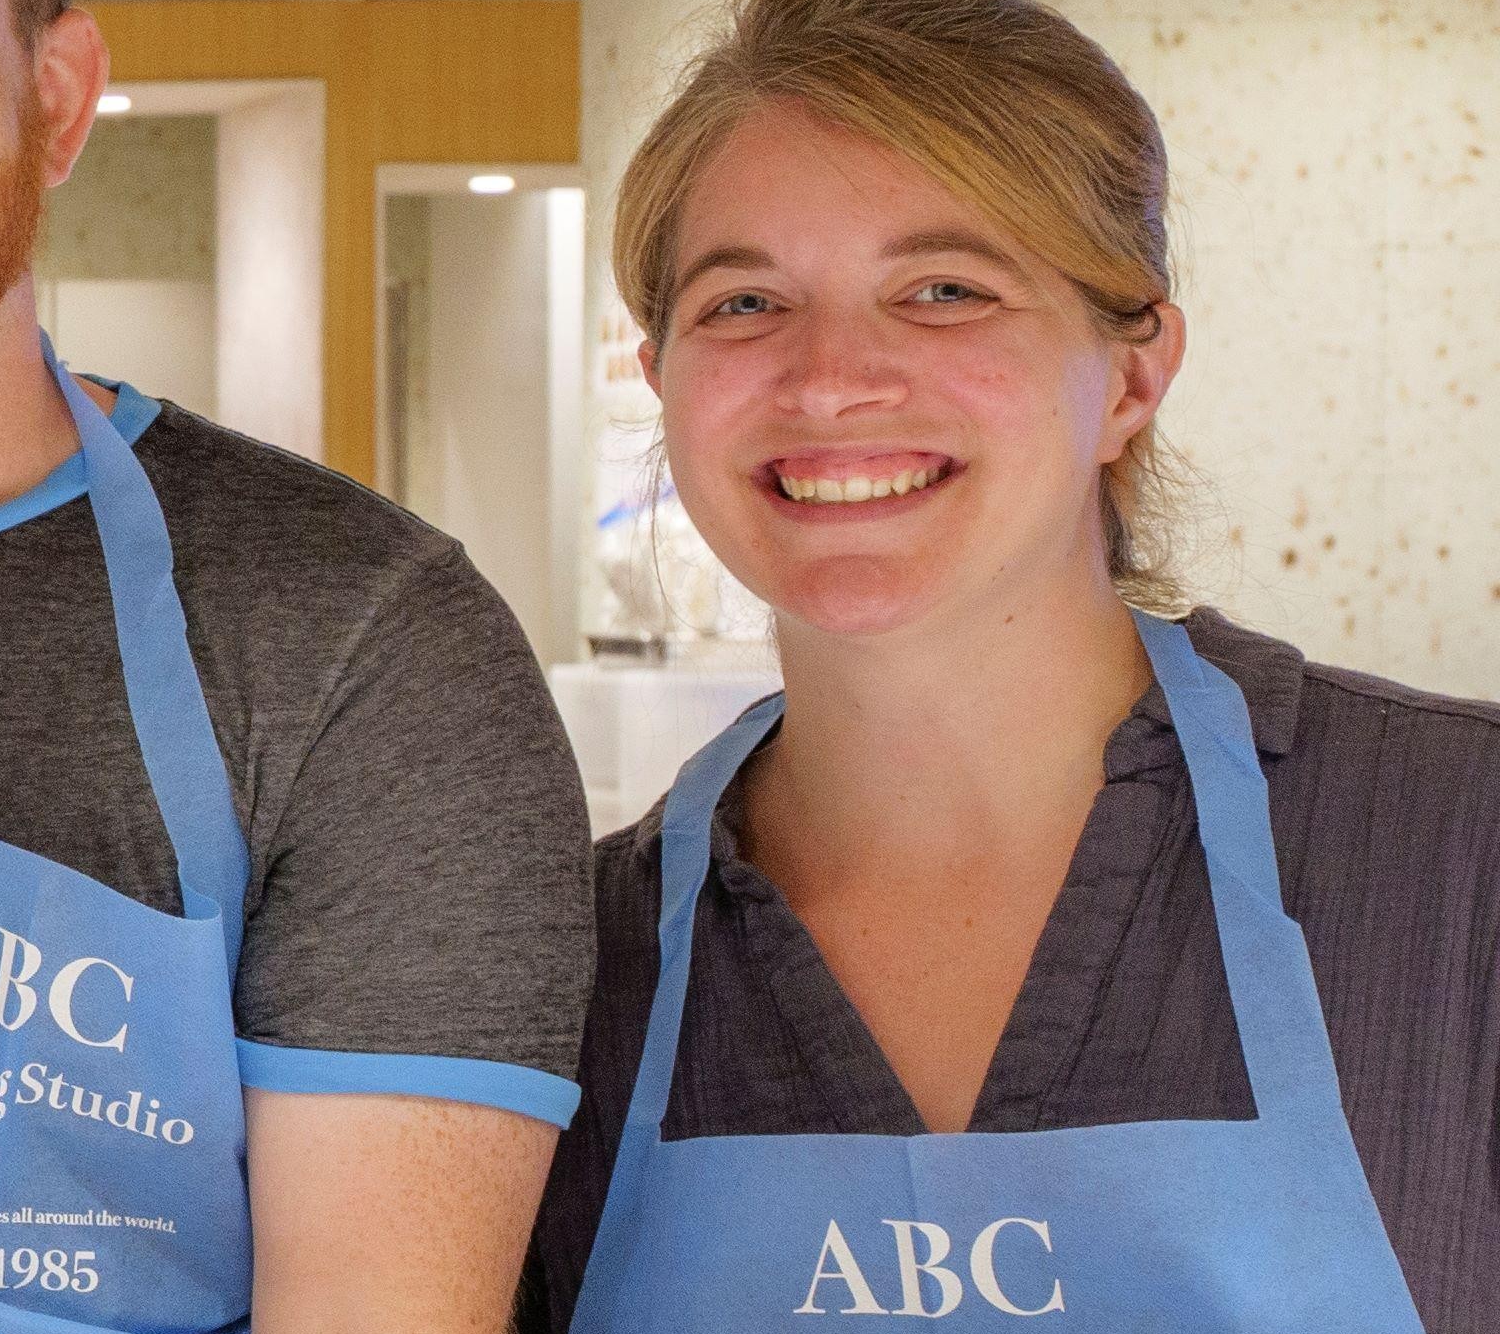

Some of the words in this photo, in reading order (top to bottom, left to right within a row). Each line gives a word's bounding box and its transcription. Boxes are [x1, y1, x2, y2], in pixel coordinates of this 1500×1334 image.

[15, 1062, 196, 1146] Studio
[12, 1207, 33, 1224] all
[35, 1209, 94, 1226] around
[96, 1210, 122, 1227] the
[124, 1216, 178, 1234] world.
[793, 1217, 1066, 1318] ABC
